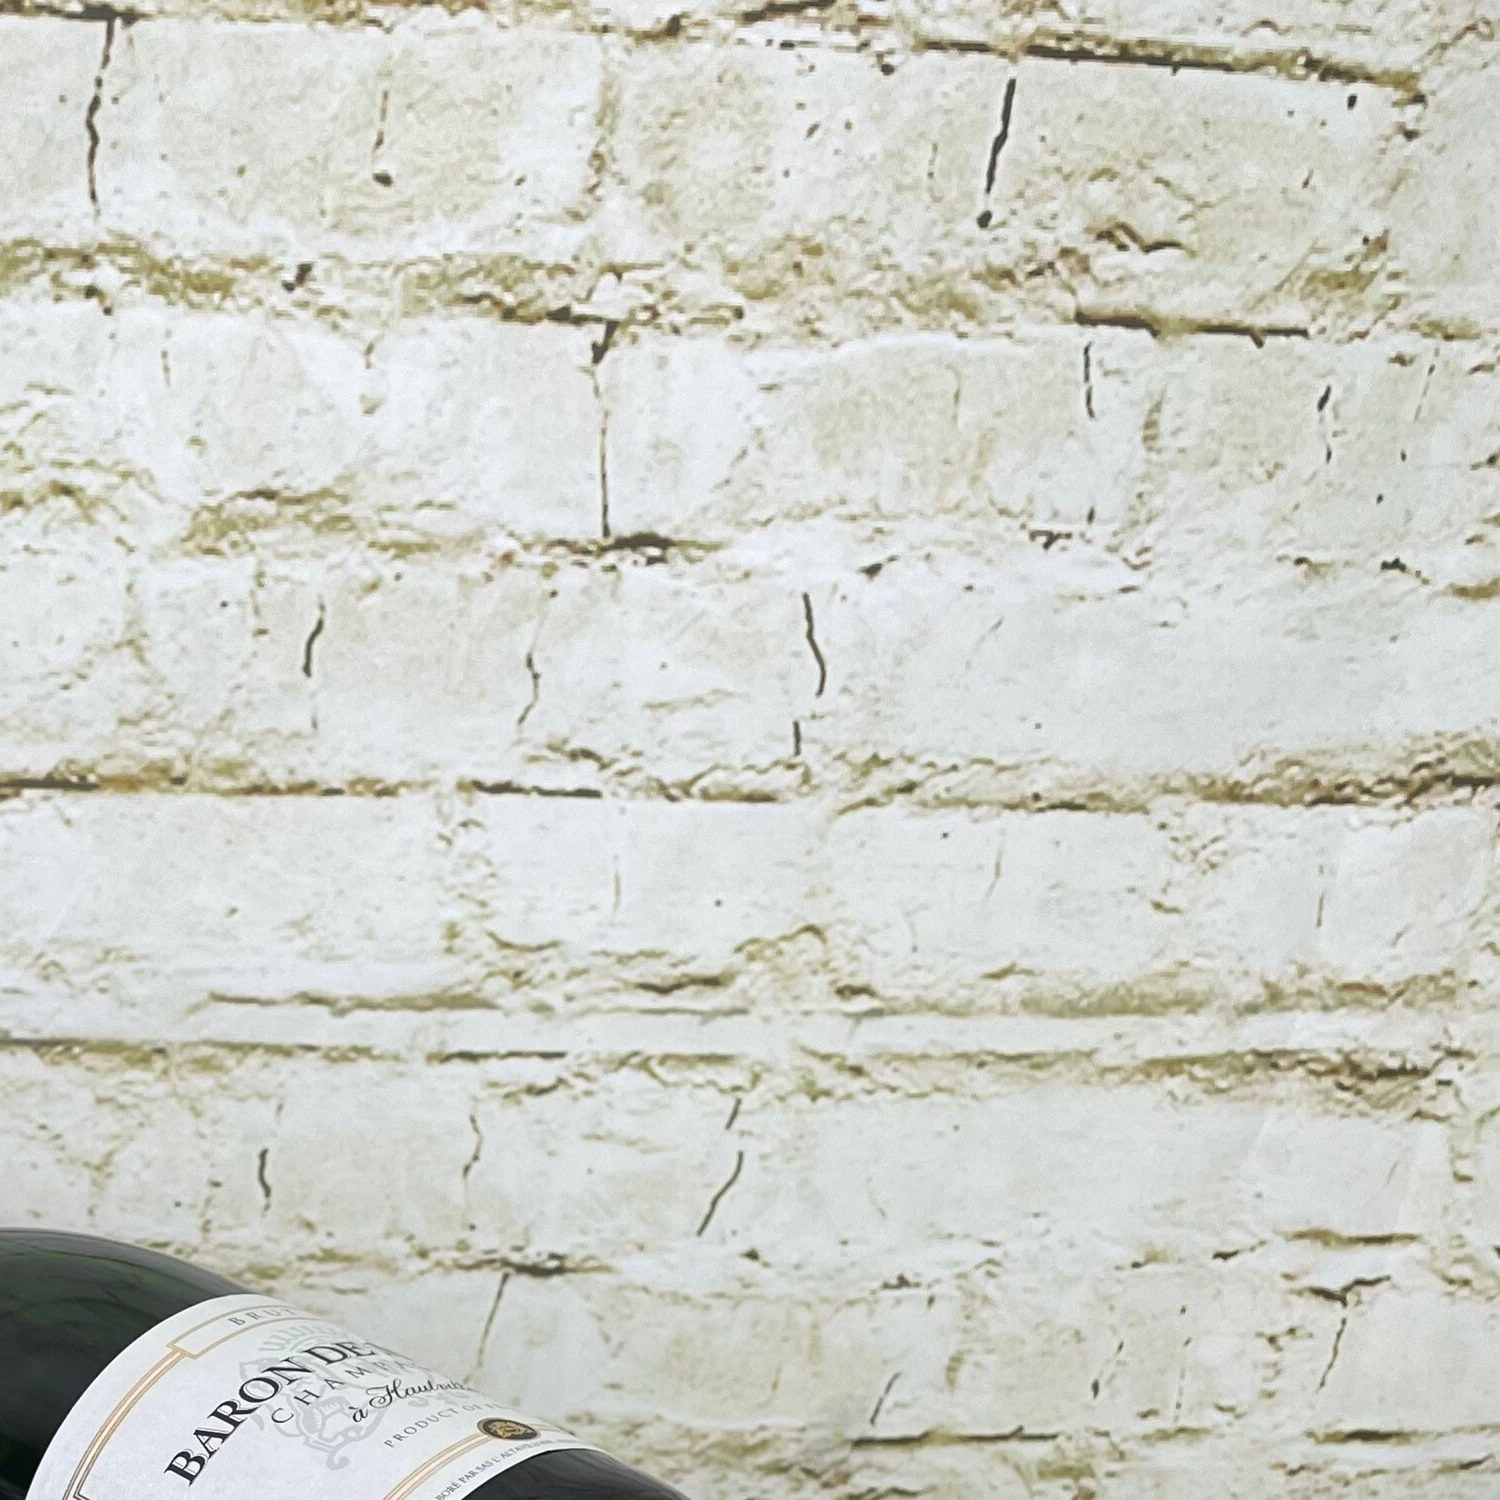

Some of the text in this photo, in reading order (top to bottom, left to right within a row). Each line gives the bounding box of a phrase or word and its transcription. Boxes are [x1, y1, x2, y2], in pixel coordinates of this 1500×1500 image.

[228, 1308, 298, 1327] BRUT
[163, 1341, 376, 1488] BARON DE
[350, 1404, 370, 1424] à
[383, 1407, 460, 1449] PRODUCT
[459, 1465, 479, 1484] PAR
